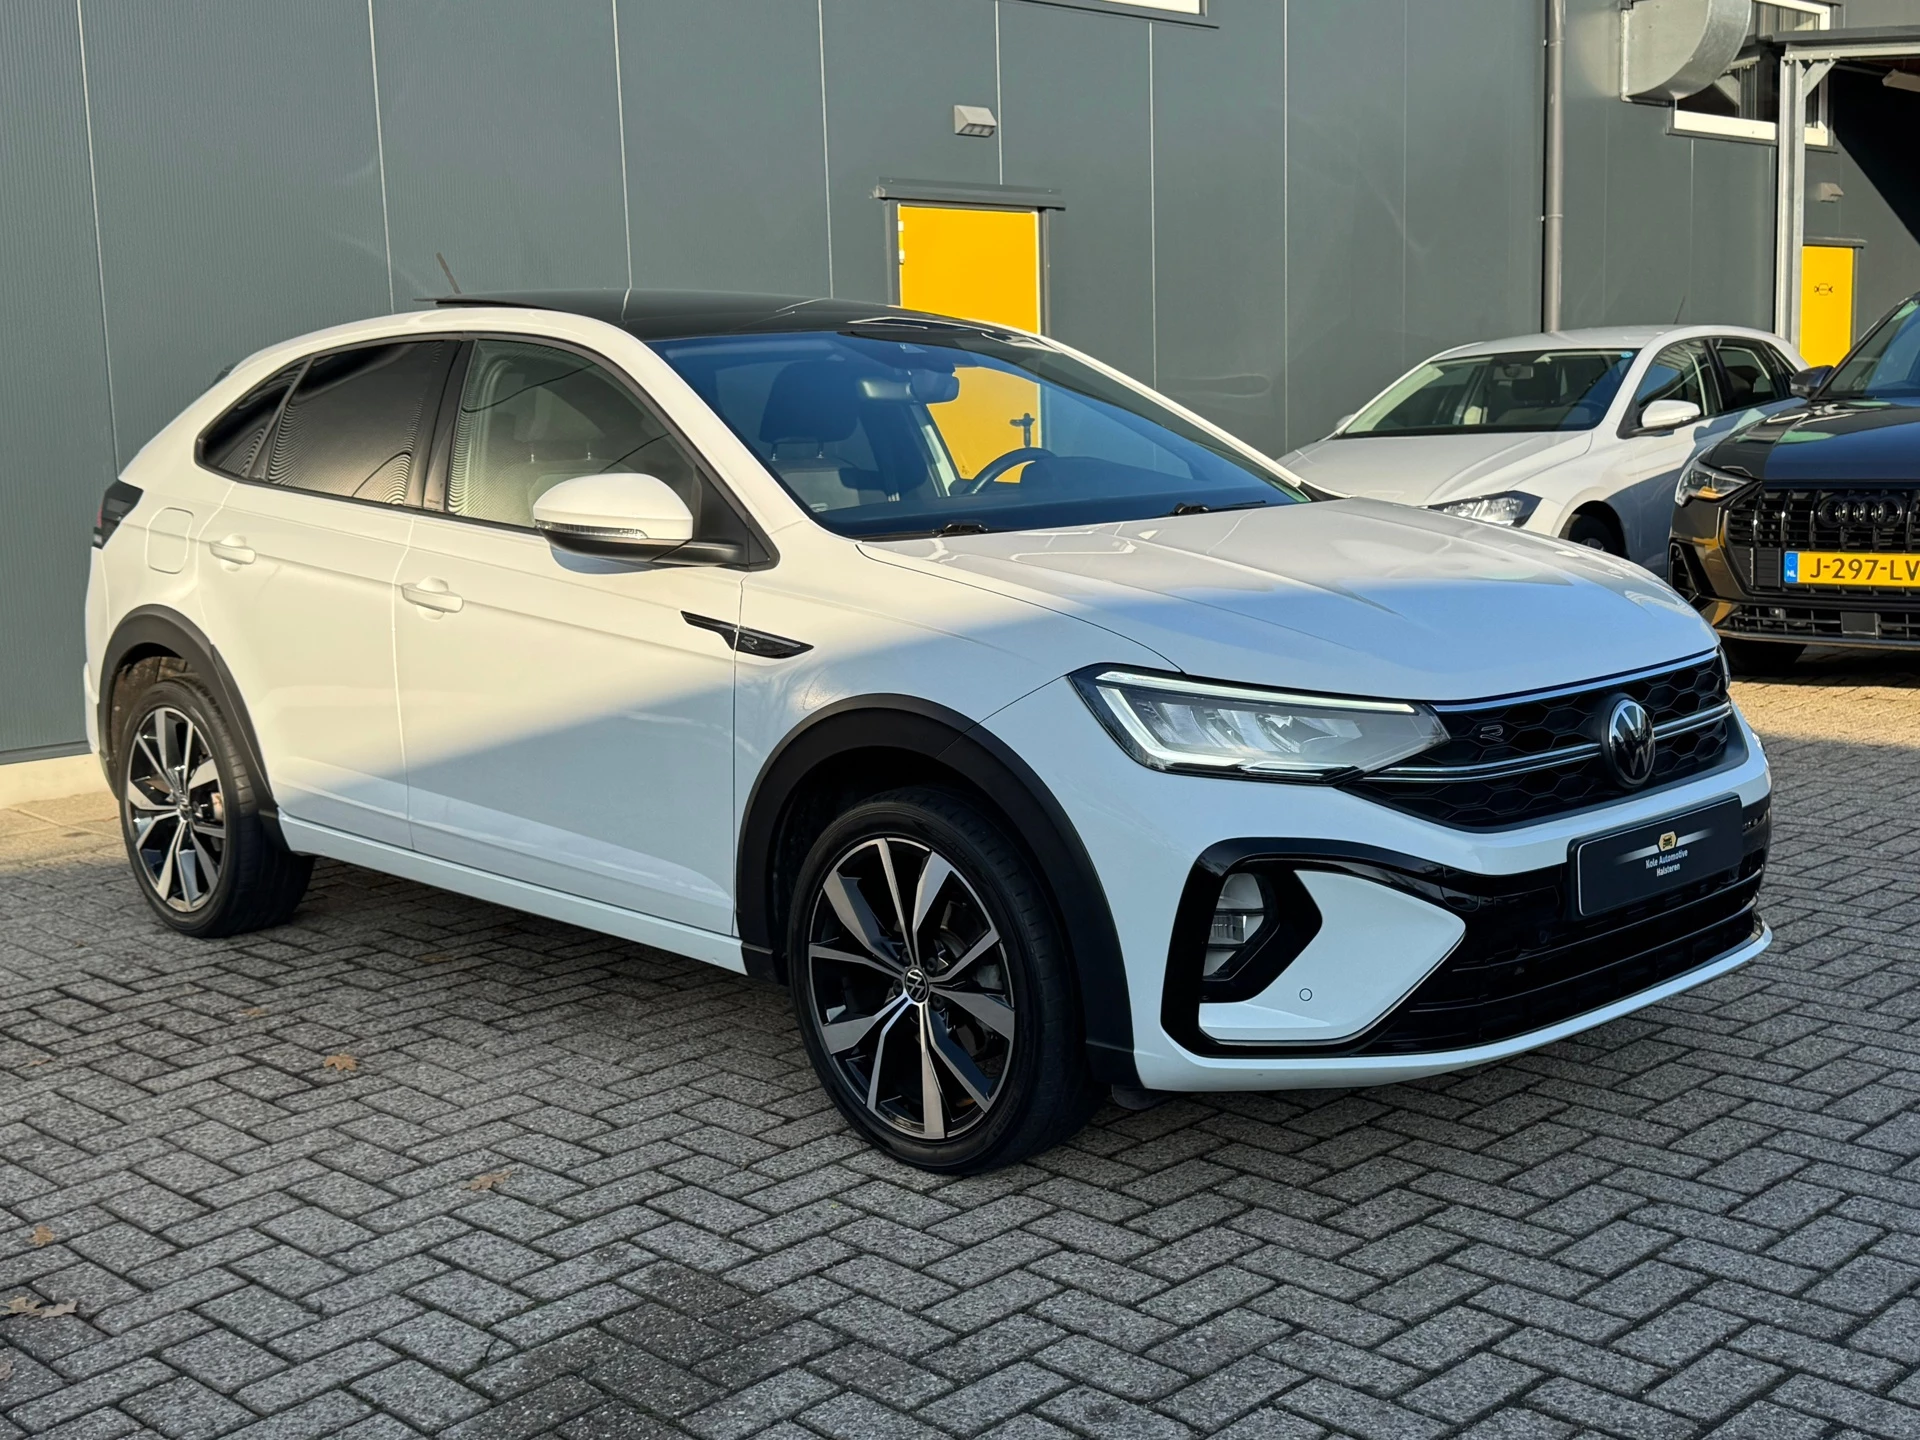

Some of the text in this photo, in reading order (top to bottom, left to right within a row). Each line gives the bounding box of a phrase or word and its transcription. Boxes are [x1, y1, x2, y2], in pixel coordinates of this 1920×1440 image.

[1786, 557, 1920, 581] NL J-297-LV
[1645, 849, 1688, 870] Kole Automotive
[1656, 863, 1681, 877] Halsteren
